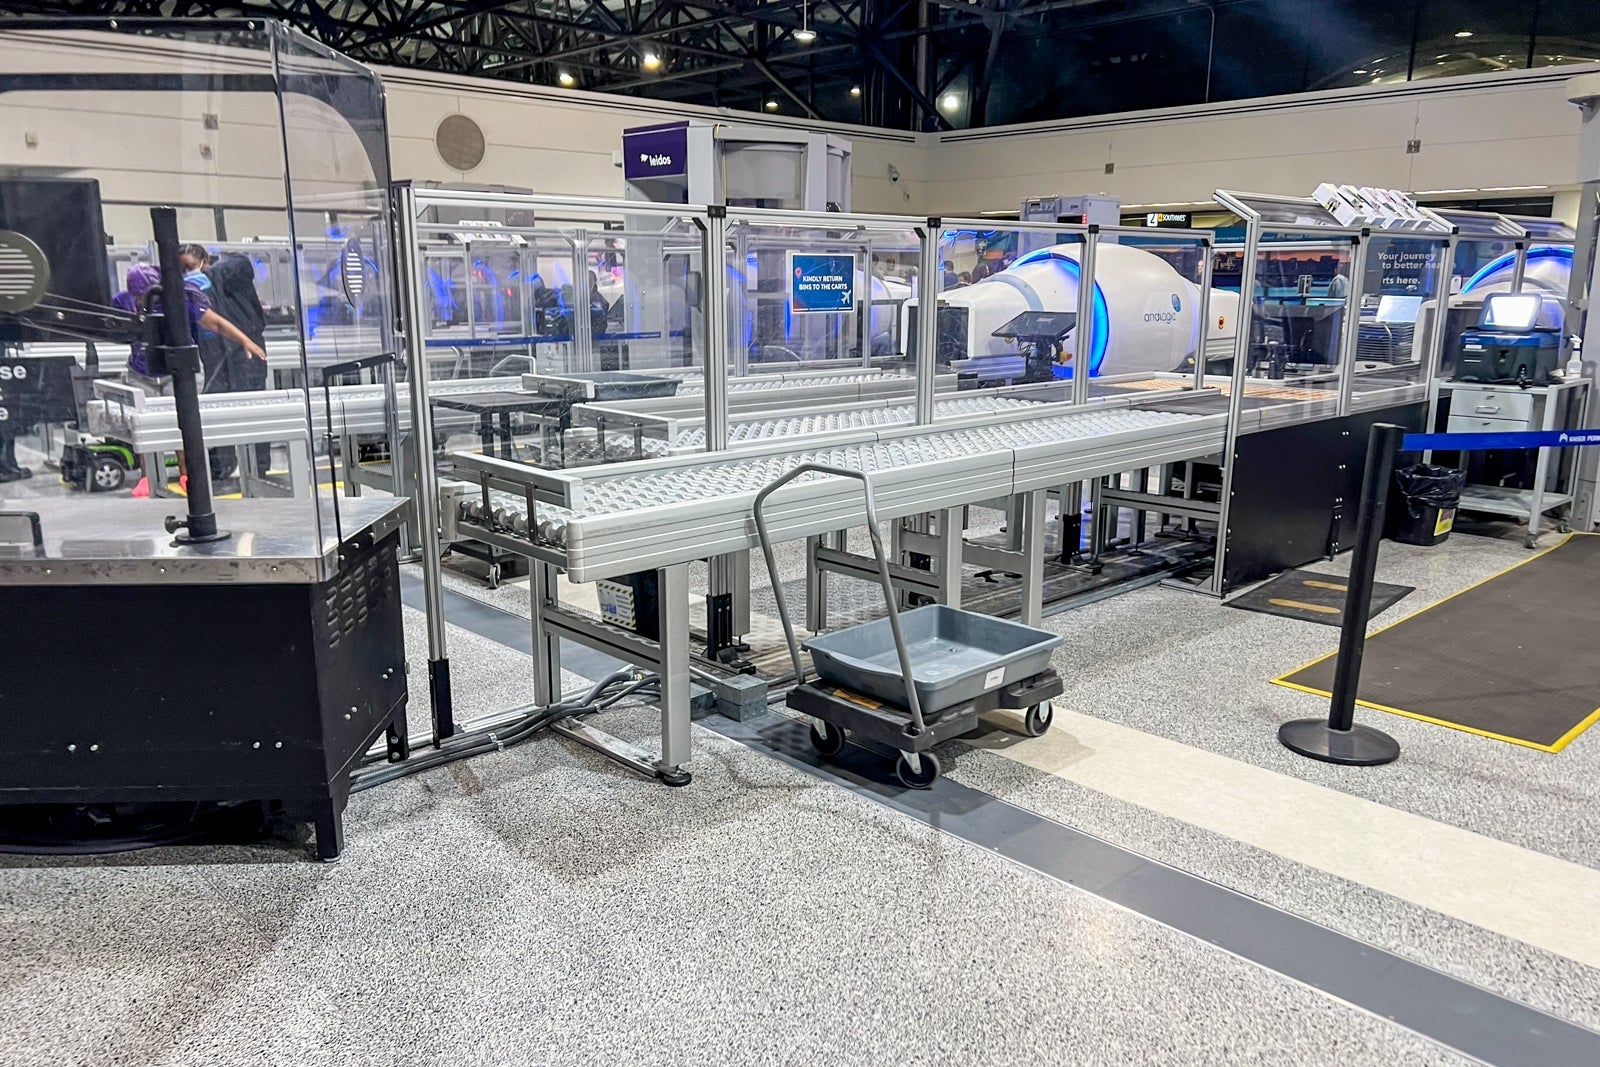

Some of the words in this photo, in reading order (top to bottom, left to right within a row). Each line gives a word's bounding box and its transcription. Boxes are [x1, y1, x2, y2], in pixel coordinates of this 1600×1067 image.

[649, 154, 671, 166] leidos
[1377, 252, 1398, 260] Your
[1399, 251, 1436, 262] journey
[1382, 261, 1391, 269] to
[1394, 260, 1422, 269] better
[1396, 275, 1421, 284] here.
[1144, 311, 1176, 324] analogic
